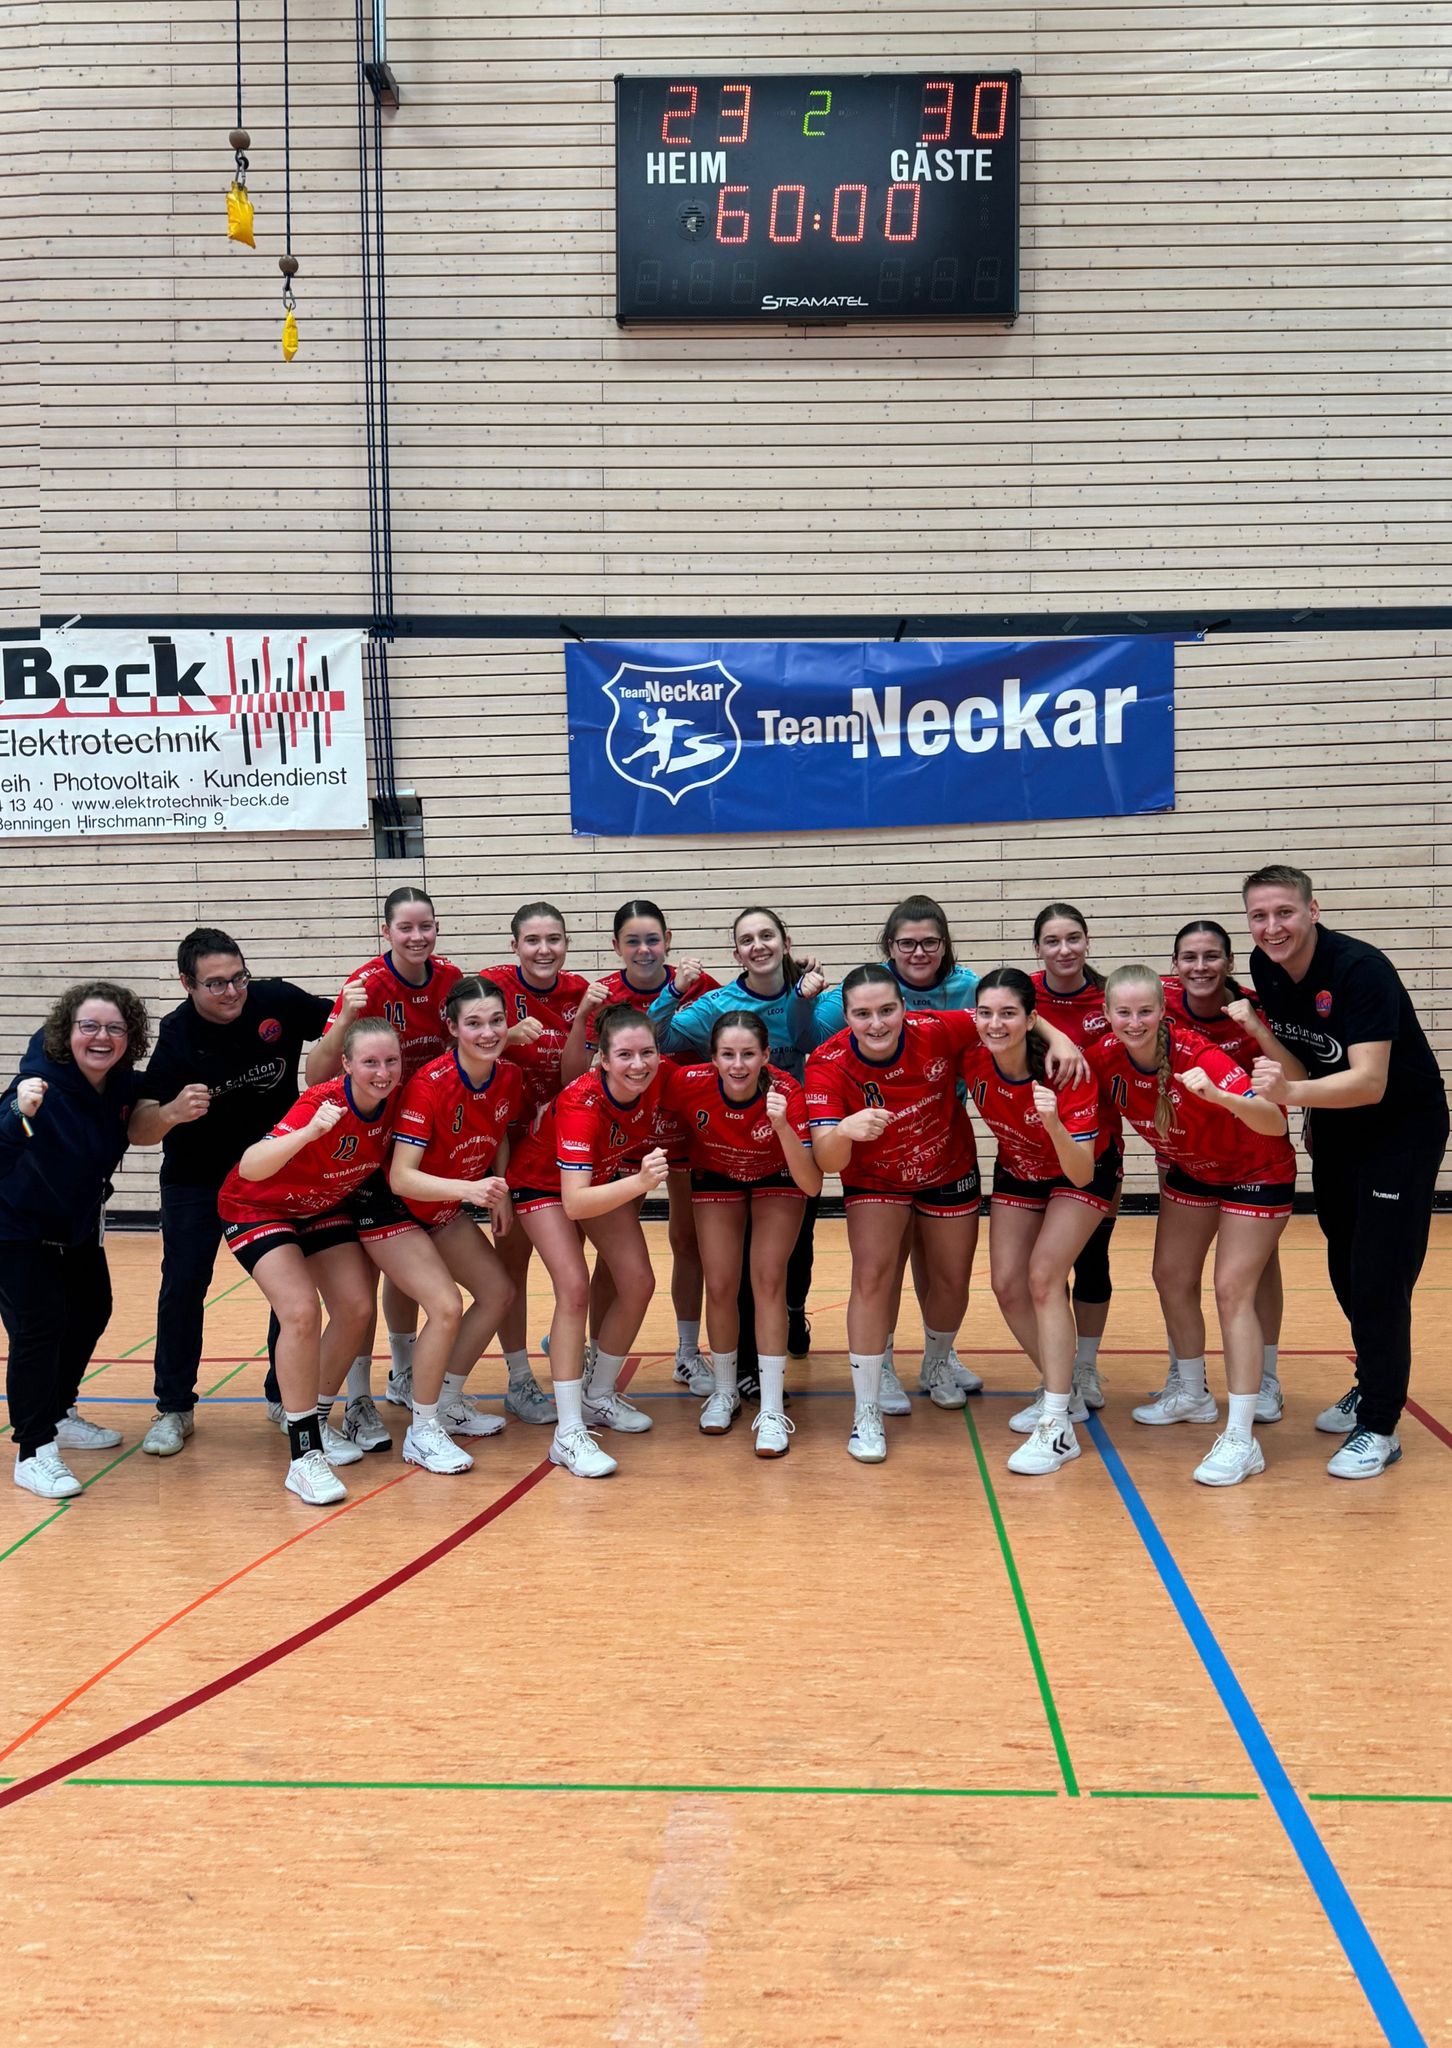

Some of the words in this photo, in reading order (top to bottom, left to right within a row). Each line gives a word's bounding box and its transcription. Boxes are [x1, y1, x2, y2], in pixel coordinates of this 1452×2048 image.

[661, 85, 751, 144] 23
[803, 90, 833, 136] 2
[922, 81, 1008, 141] 30
[647, 151, 727, 184] HEIM
[890, 142, 993, 181] GÄSTE
[716, 183, 921, 243] 60:00
[761, 295, 869, 310] STRAMATEL
[2, 636, 217, 715] Beck
[53, 770, 180, 792] Photovoltaik
[204, 767, 348, 788] Kundendienst
[9, 799, 27, 812] 13
[33, 798, 54, 812] 40
[72, 793, 289, 810] www.elektrotechnik-beck.de
[78, 812, 207, 829] Hirschmann-Ring
[214, 812, 224, 826] 9
[412, 995, 429, 1003] LEOS
[515, 993, 527, 1021] 5
[383, 1000, 406, 1032] 14
[768, 1007, 785, 1016] LEOS
[884, 1067, 905, 1080] LEOS
[1134, 1079, 1152, 1089] LEOS
[997, 1086, 1014, 1099] LEOS
[452, 1103, 464, 1133] 3
[631, 1109, 645, 1123] LEOS
[696, 1109, 709, 1135] 2
[725, 1111, 745, 1120] LEOS
[331, 1135, 359, 1161] 12
[1372, 1189, 1400, 1200] hummel
[226, 1224, 238, 1235] LEOS
[360, 1218, 374, 1226] LEOS
